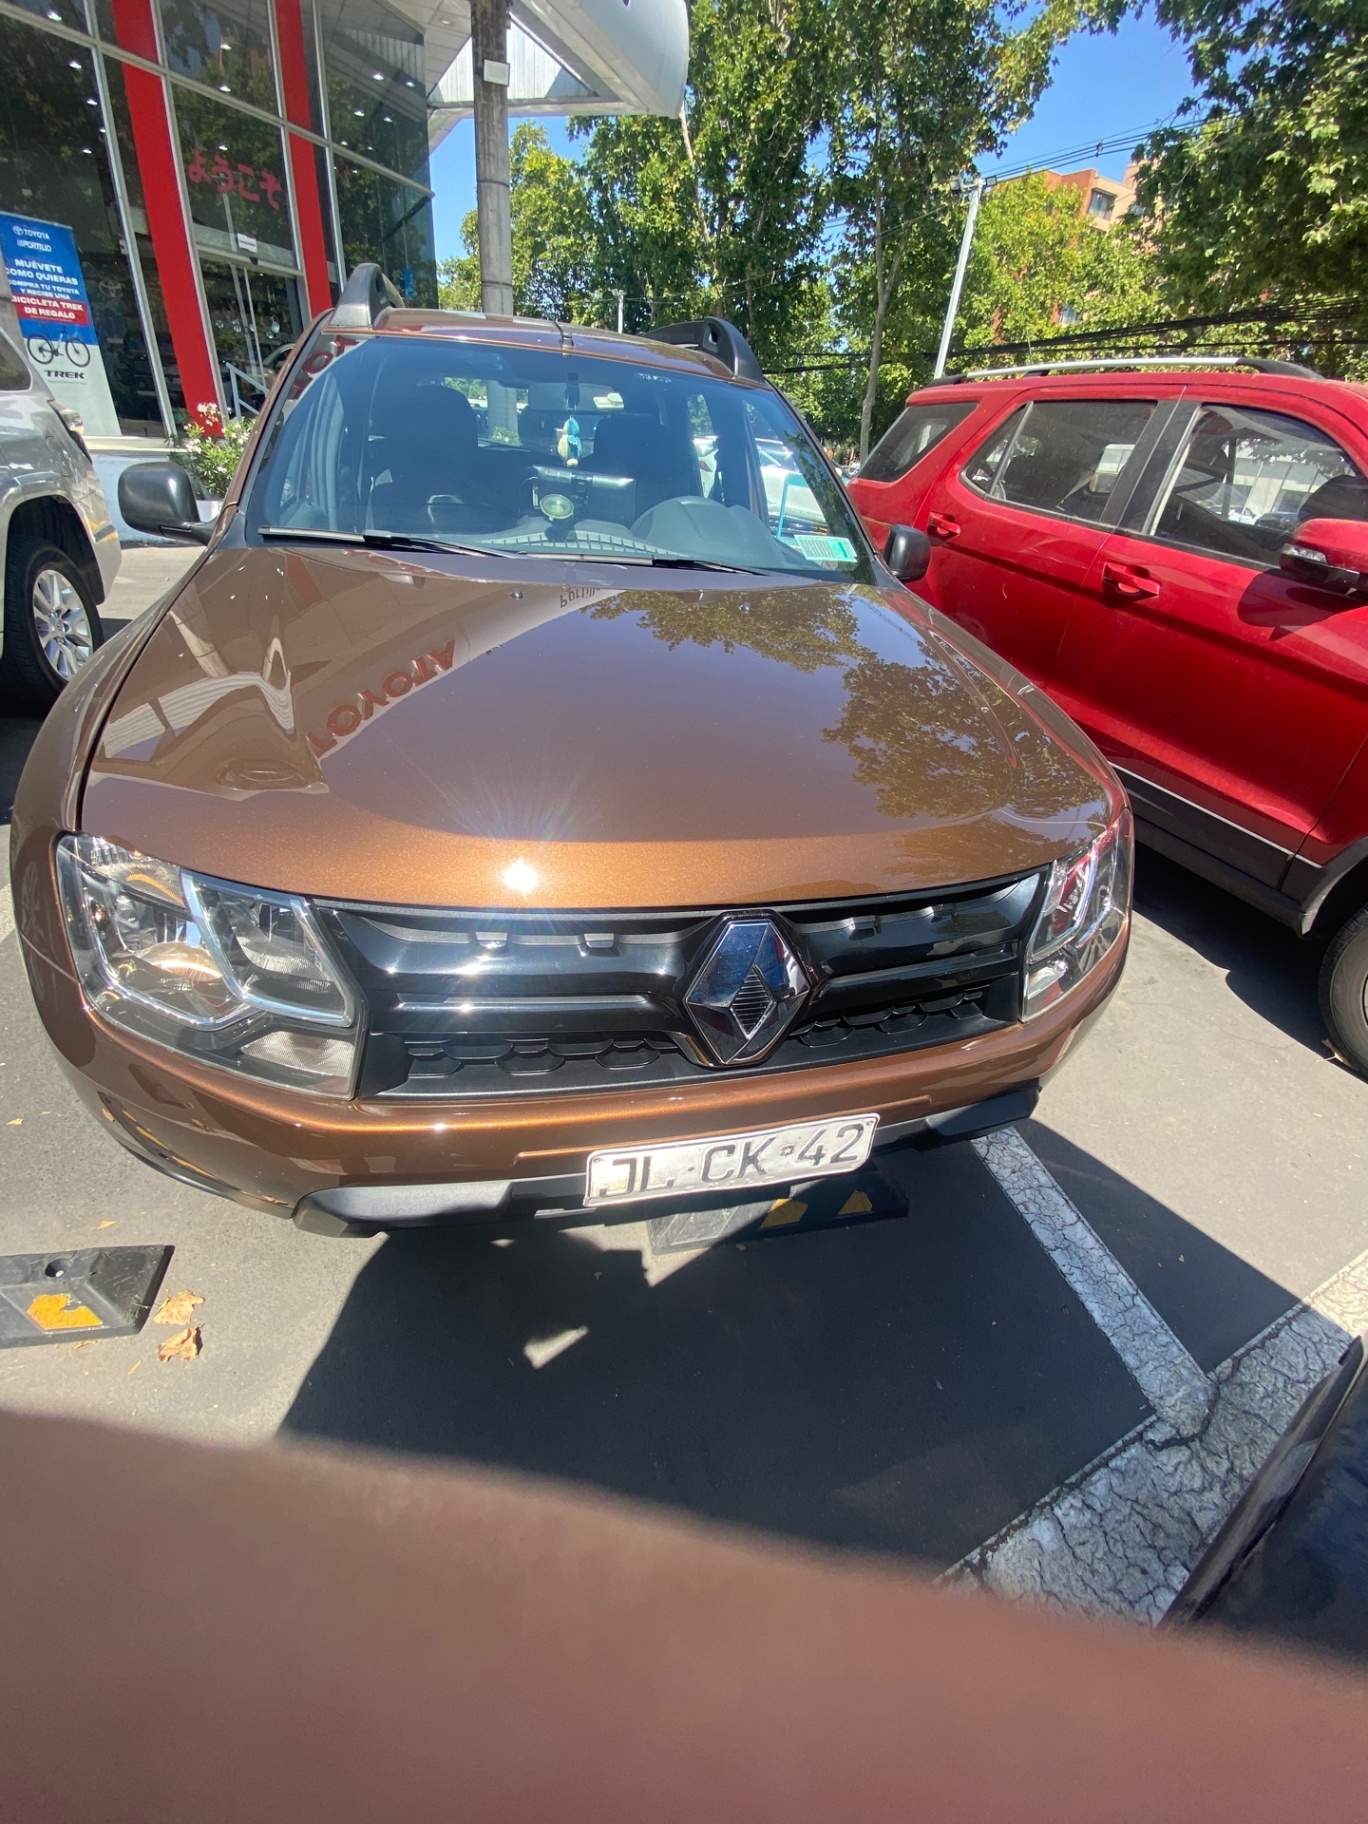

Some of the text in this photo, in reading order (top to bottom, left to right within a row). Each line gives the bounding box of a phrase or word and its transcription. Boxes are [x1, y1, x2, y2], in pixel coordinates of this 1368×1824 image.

[188, 146, 282, 210] ようこそ
[24, 228, 50, 239] TOYOTA
[36, 271, 78, 286] QUIERAS
[60, 301, 84, 311] TREK
[25, 307, 38, 315] DE
[39, 308, 76, 319] REGALO
[45, 369, 86, 379] TREK
